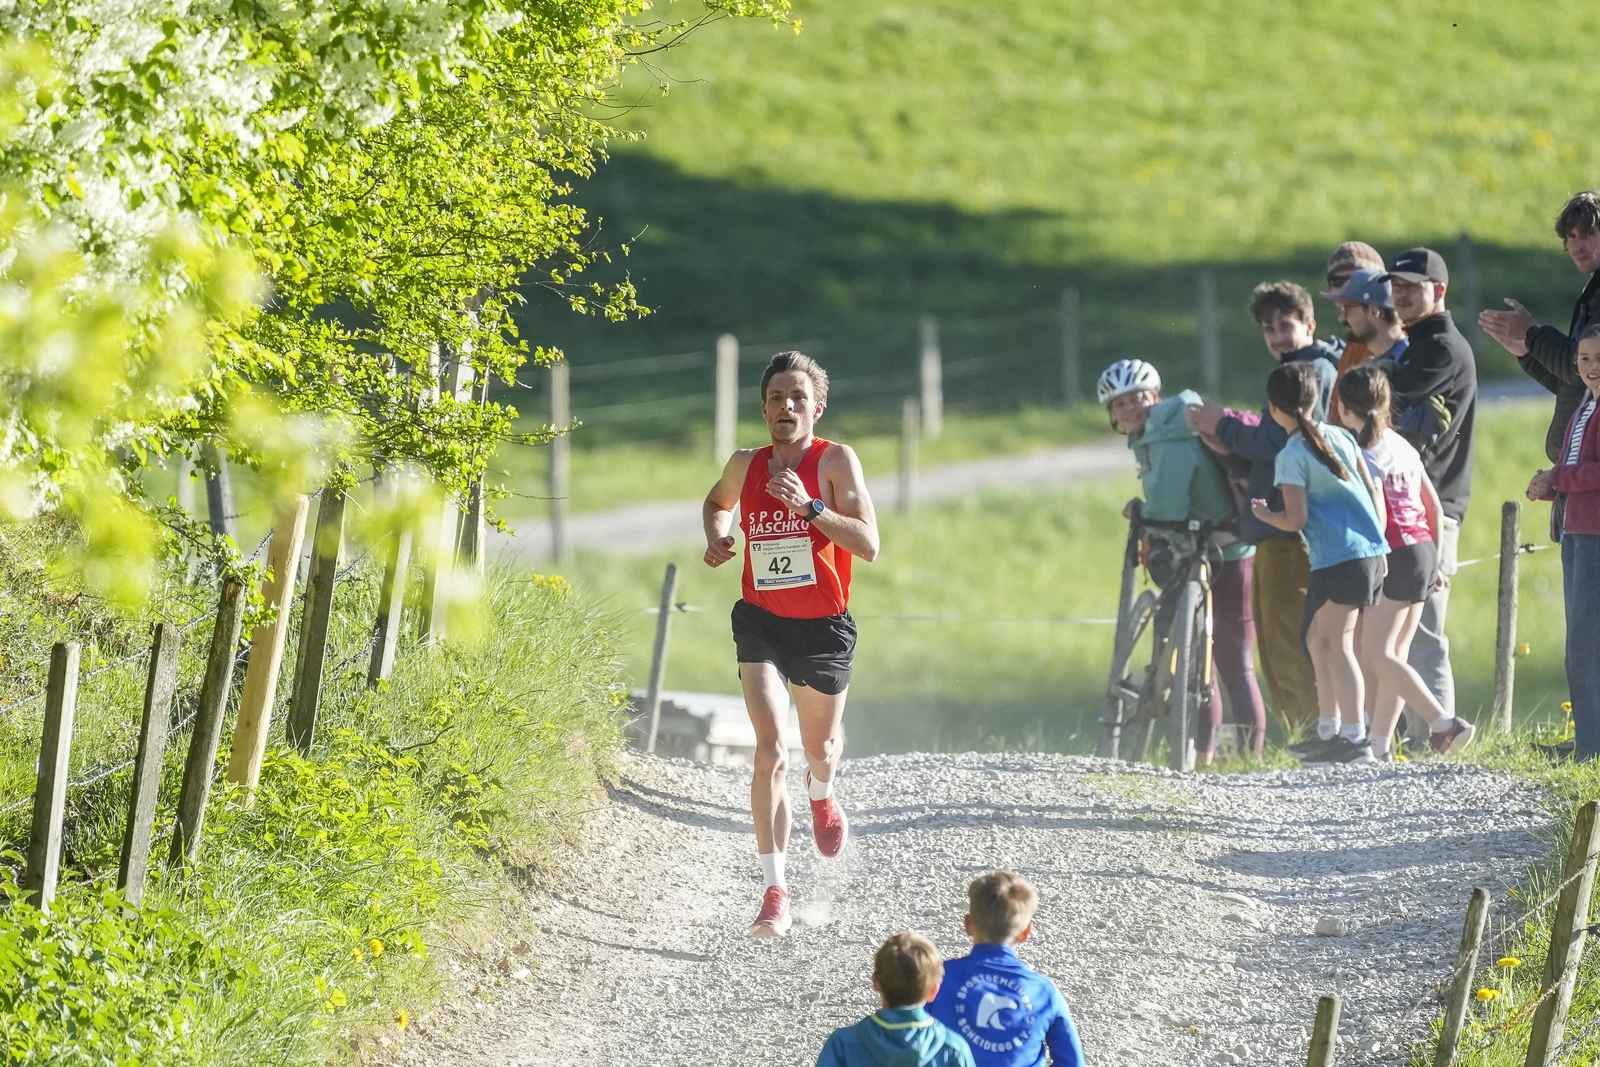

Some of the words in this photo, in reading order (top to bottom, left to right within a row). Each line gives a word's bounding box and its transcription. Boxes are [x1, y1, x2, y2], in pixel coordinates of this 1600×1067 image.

[749, 510, 796, 524] SPOR
[749, 519, 809, 536] HASCHKO
[769, 556, 792, 574] 42
[958, 1017, 1012, 1052] SCHEIDEGG
